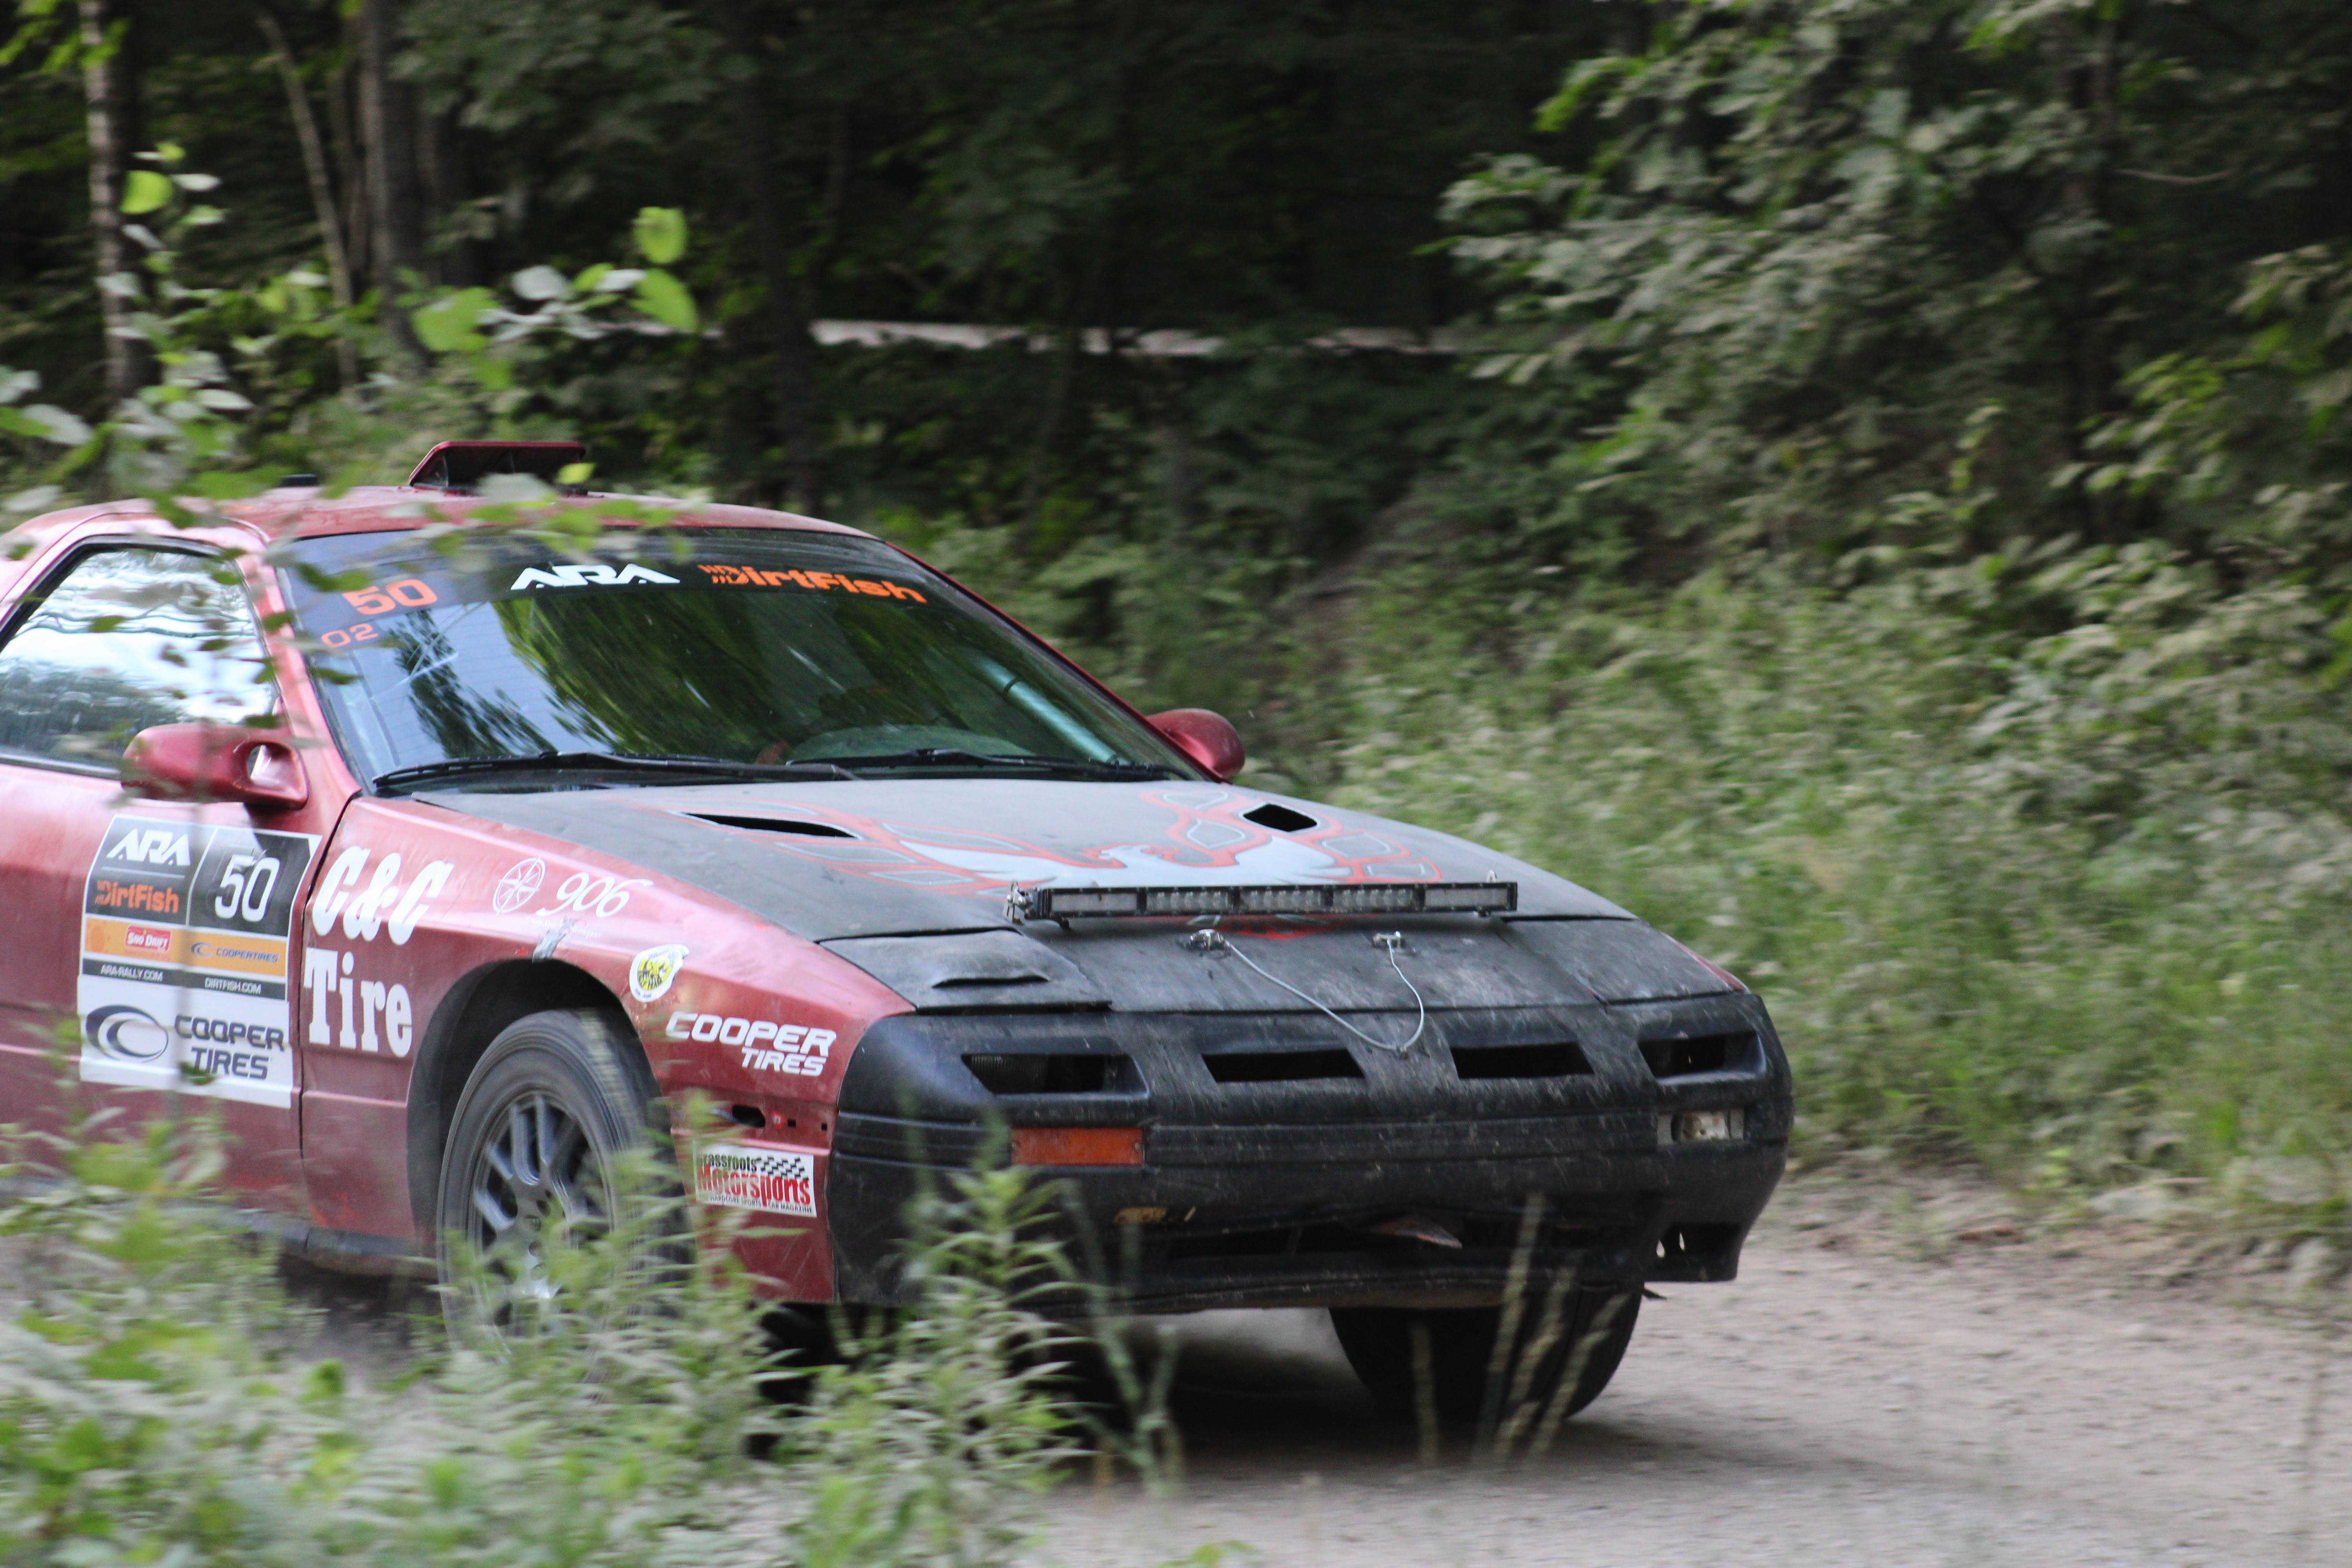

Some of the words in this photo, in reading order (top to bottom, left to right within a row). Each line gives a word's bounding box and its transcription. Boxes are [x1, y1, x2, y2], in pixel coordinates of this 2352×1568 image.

[341, 579, 437, 615] 50
[697, 564, 927, 603] DirtFish
[106, 828, 191, 866] ARA
[94, 880, 180, 913] DirtFish
[214, 854, 281, 922] 50
[312, 846, 455, 946] C&C
[535, 872, 654, 918] 906
[304, 947, 413, 1058] Tire
[174, 1013, 285, 1052] COOPER
[666, 1011, 837, 1057] COOPER
[191, 1046, 270, 1080] TIRES
[741, 1047, 827, 1076] TIRES
[697, 1154, 757, 1172] rassroots
[697, 1163, 811, 1207] Motorsports
[780, 1203, 812, 1214] MAGAZINE
